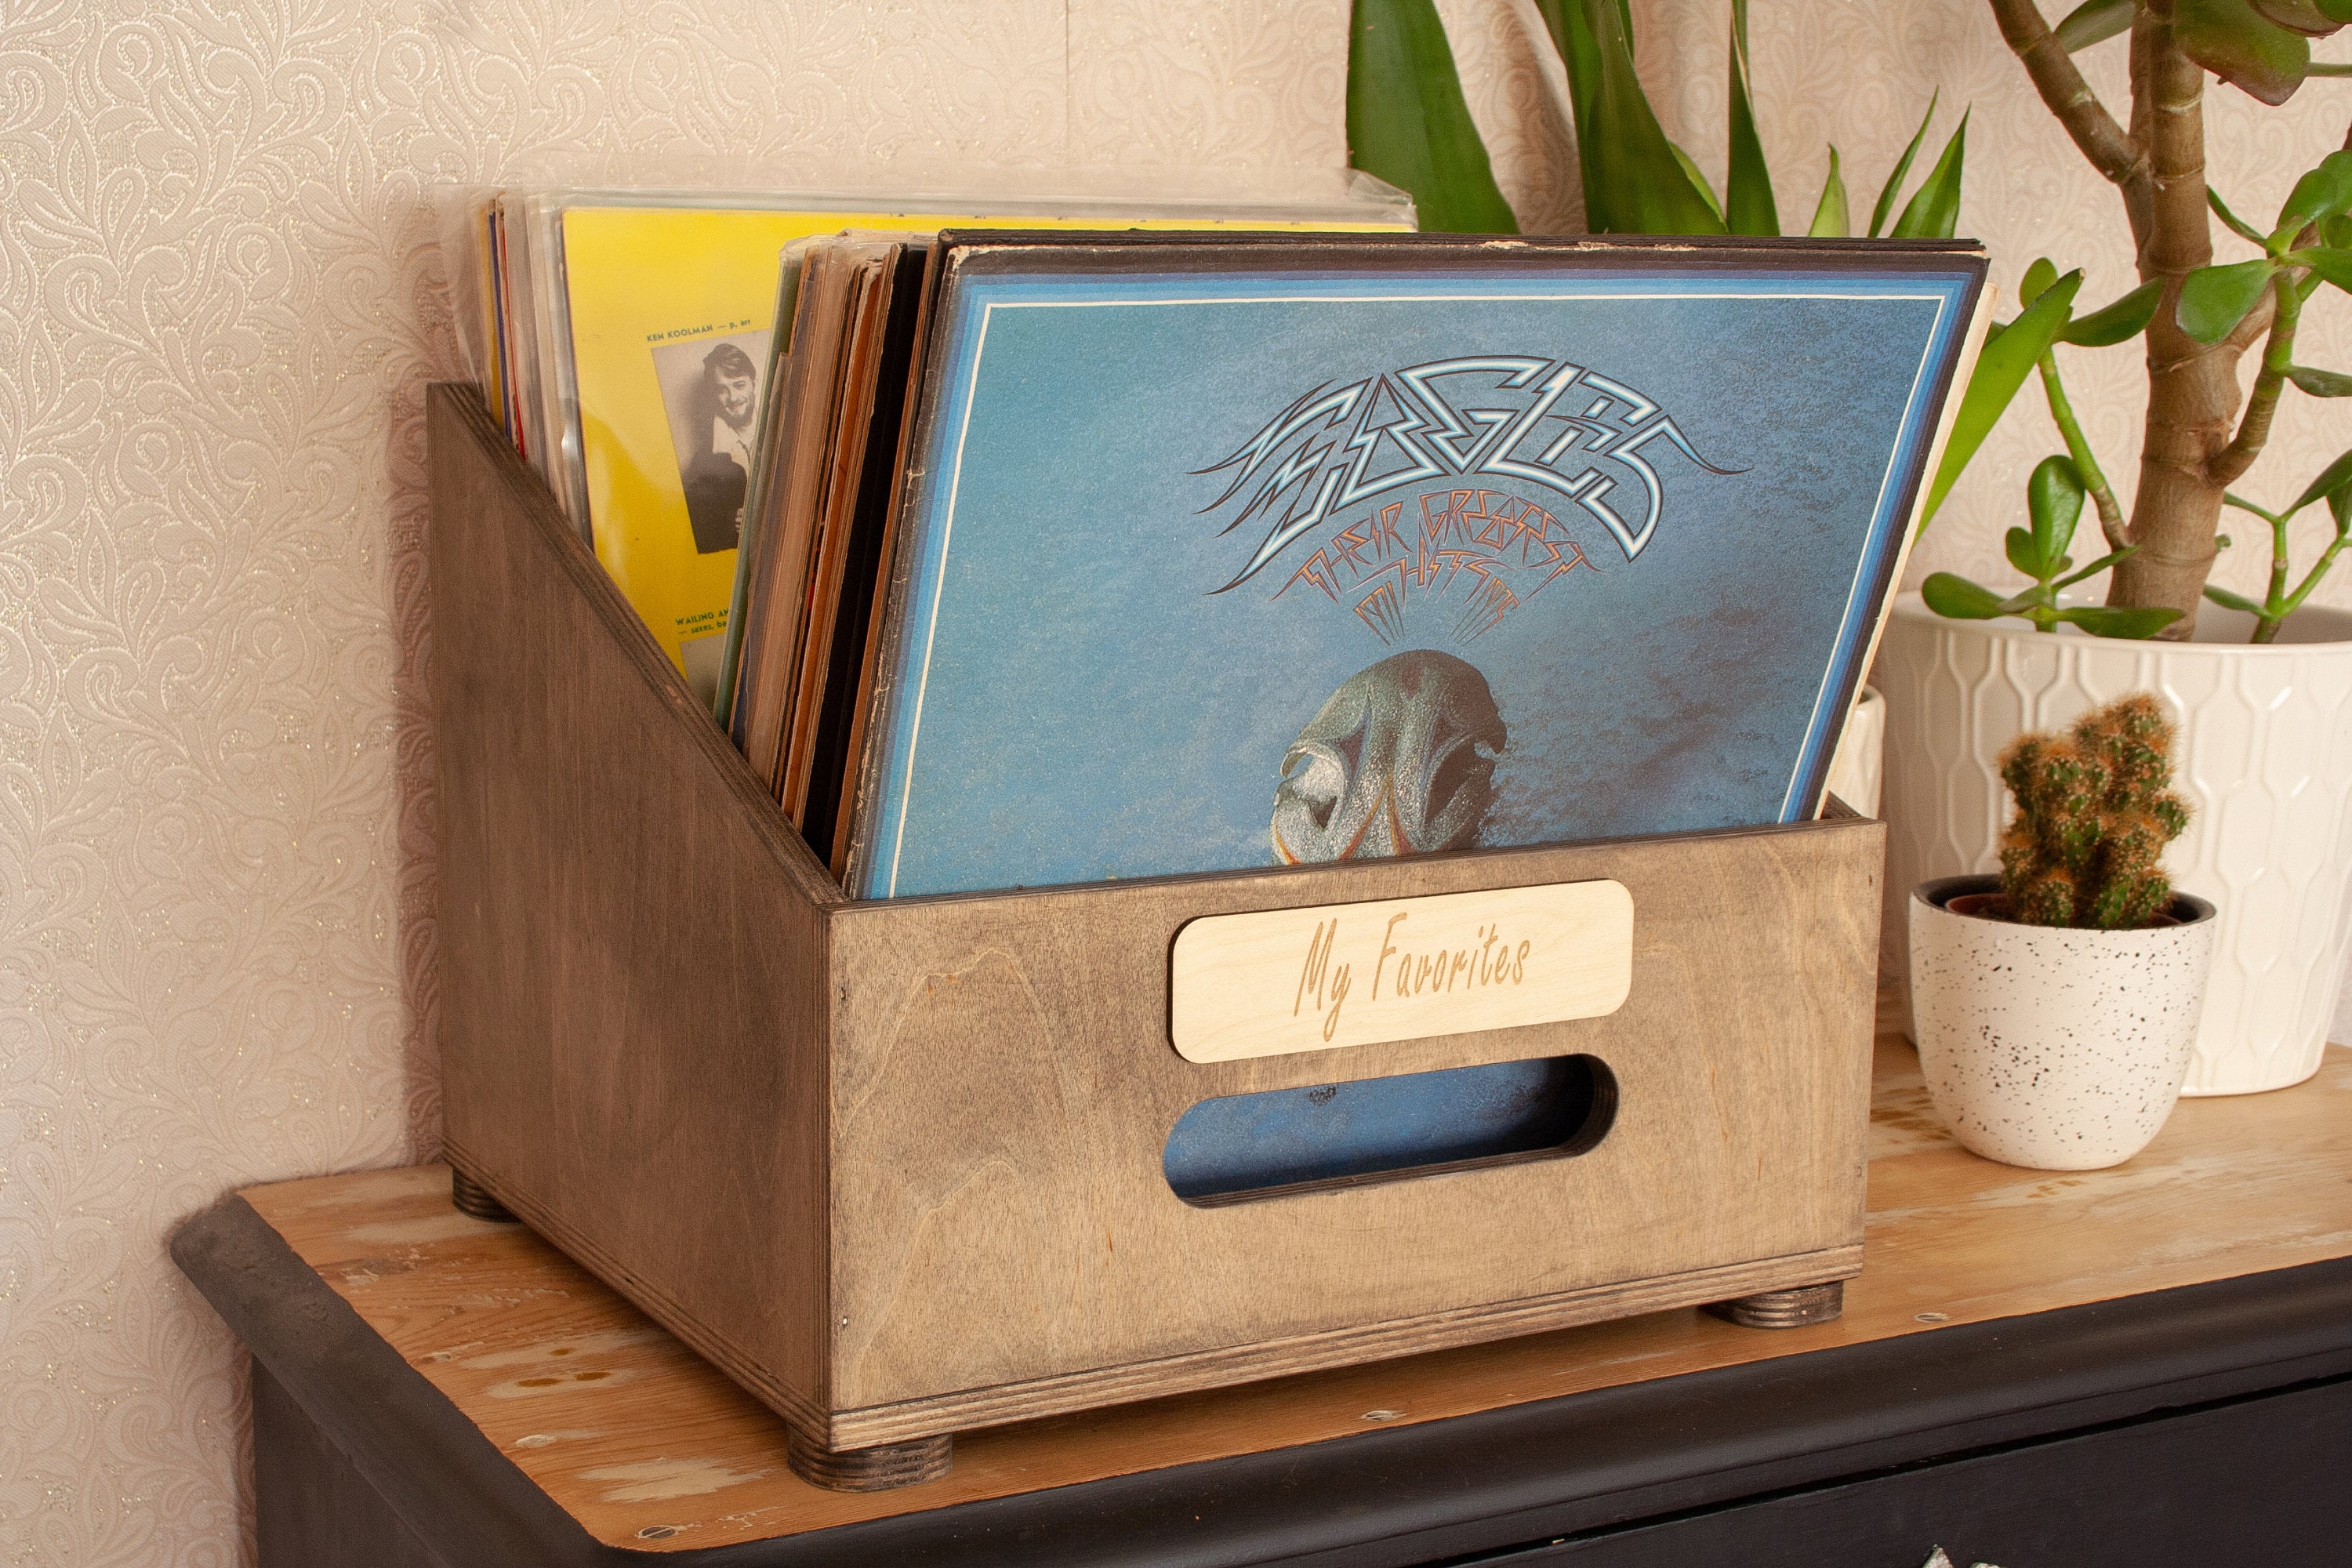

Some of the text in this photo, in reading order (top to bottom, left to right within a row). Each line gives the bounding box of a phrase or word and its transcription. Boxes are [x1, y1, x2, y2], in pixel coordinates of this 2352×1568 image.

[646, 332, 664, 343] KEN
[667, 324, 713, 339] KOOLMAN
[1183, 355, 1753, 597] EAGLES
[1268, 488, 1607, 605] THEIR GREATEST
[1346, 511, 1519, 610] HITS
[1294, 912, 1531, 1043] My Favorites
